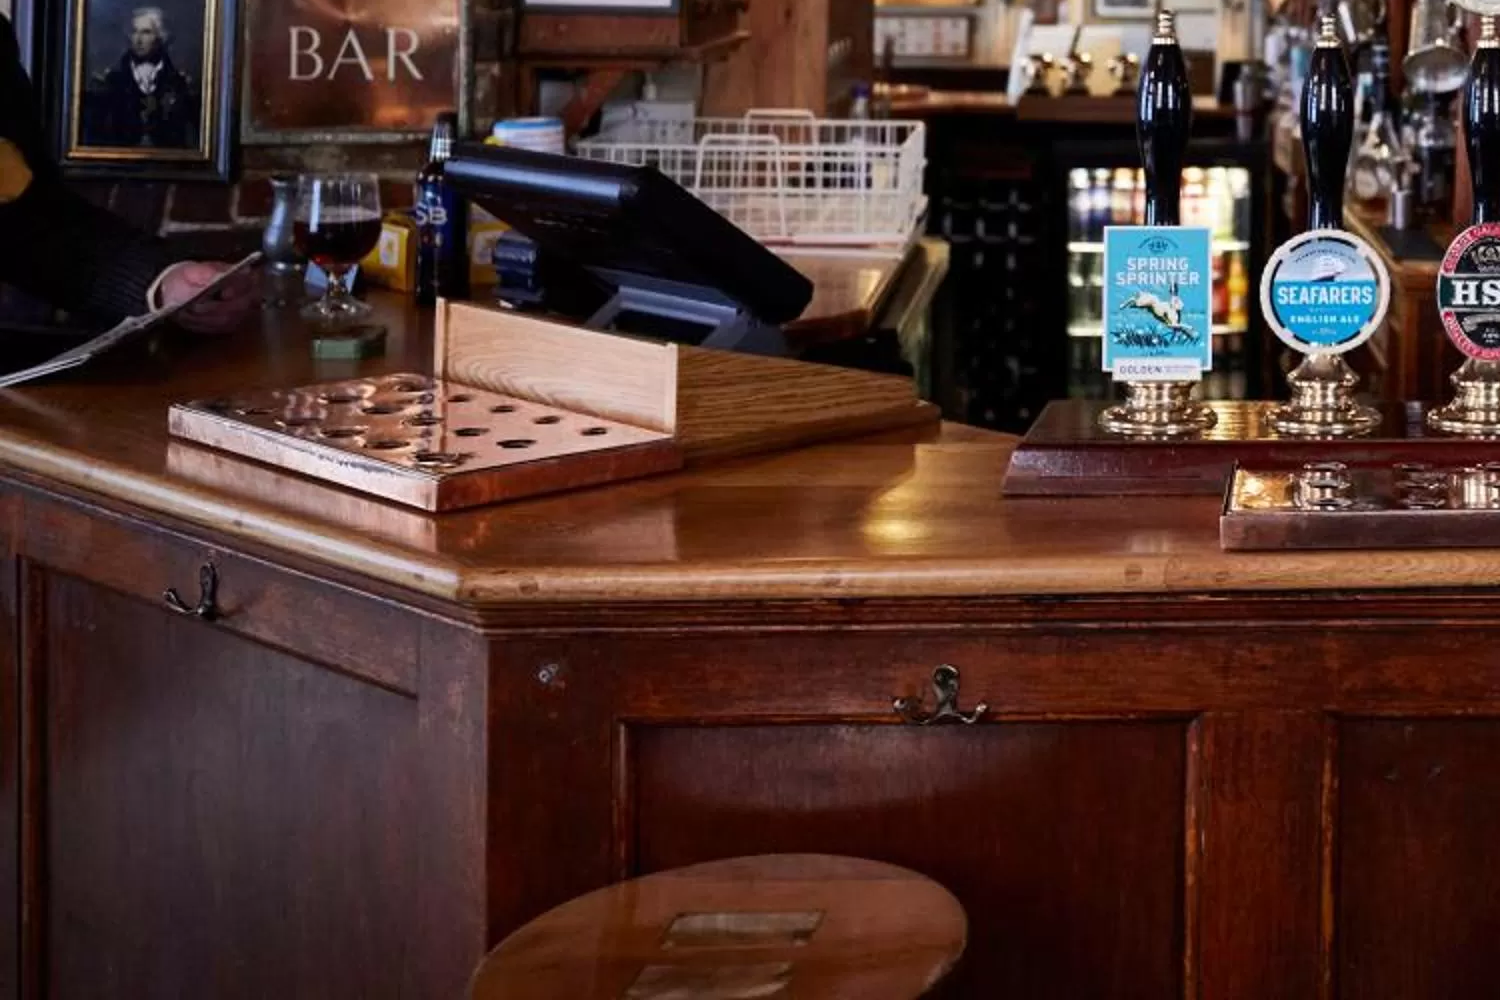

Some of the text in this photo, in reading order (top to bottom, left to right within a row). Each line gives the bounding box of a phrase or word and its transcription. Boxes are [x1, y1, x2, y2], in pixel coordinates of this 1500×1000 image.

[288, 26, 424, 81] BAR
[1127, 257, 1189, 271] SPRING
[1115, 271, 1200, 285] SPRINTER
[1277, 285, 1374, 305] SEAFARERS
[1290, 315, 1360, 325] ENGLISH ALE
